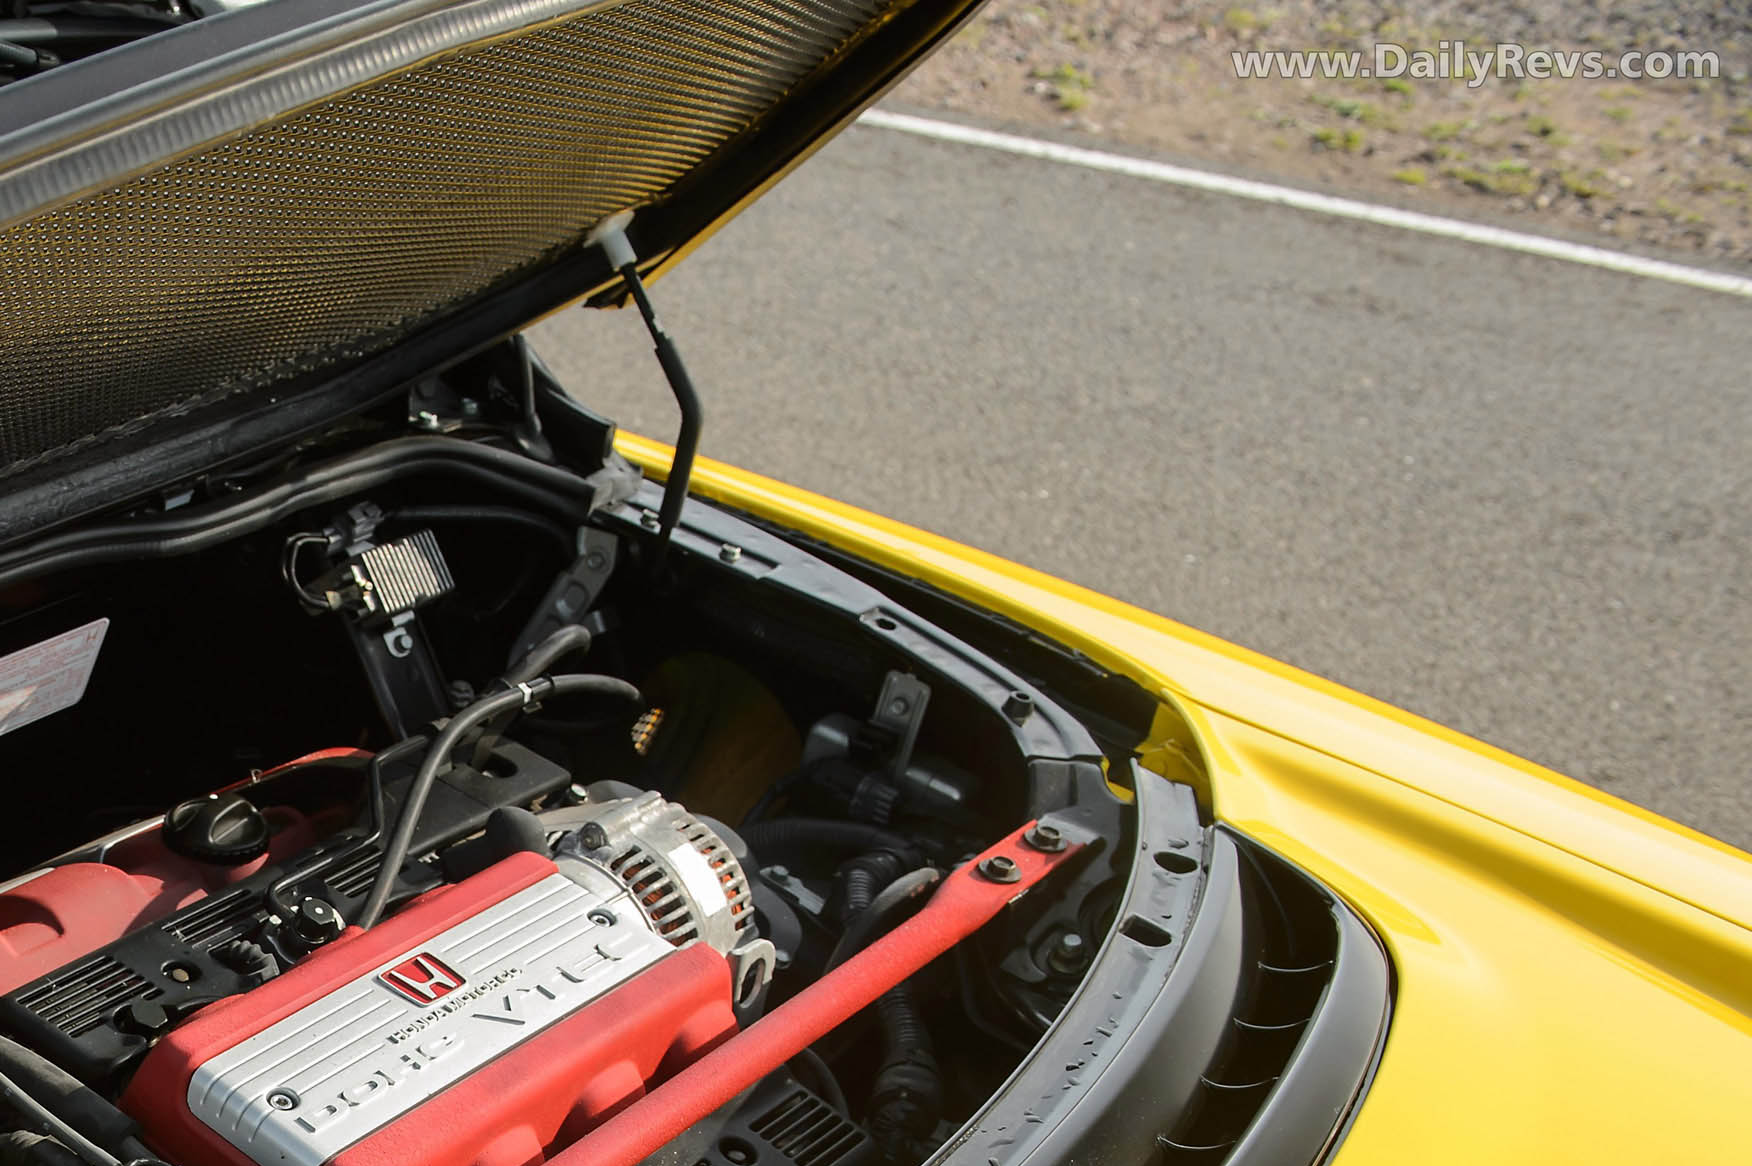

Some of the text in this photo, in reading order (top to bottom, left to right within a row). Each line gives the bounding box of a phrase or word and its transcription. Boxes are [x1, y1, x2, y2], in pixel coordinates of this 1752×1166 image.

[294, 931, 650, 1134] DOHC VTEC
[386, 1007, 447, 1045] HONDA
[443, 976, 502, 1012] MOTOR
